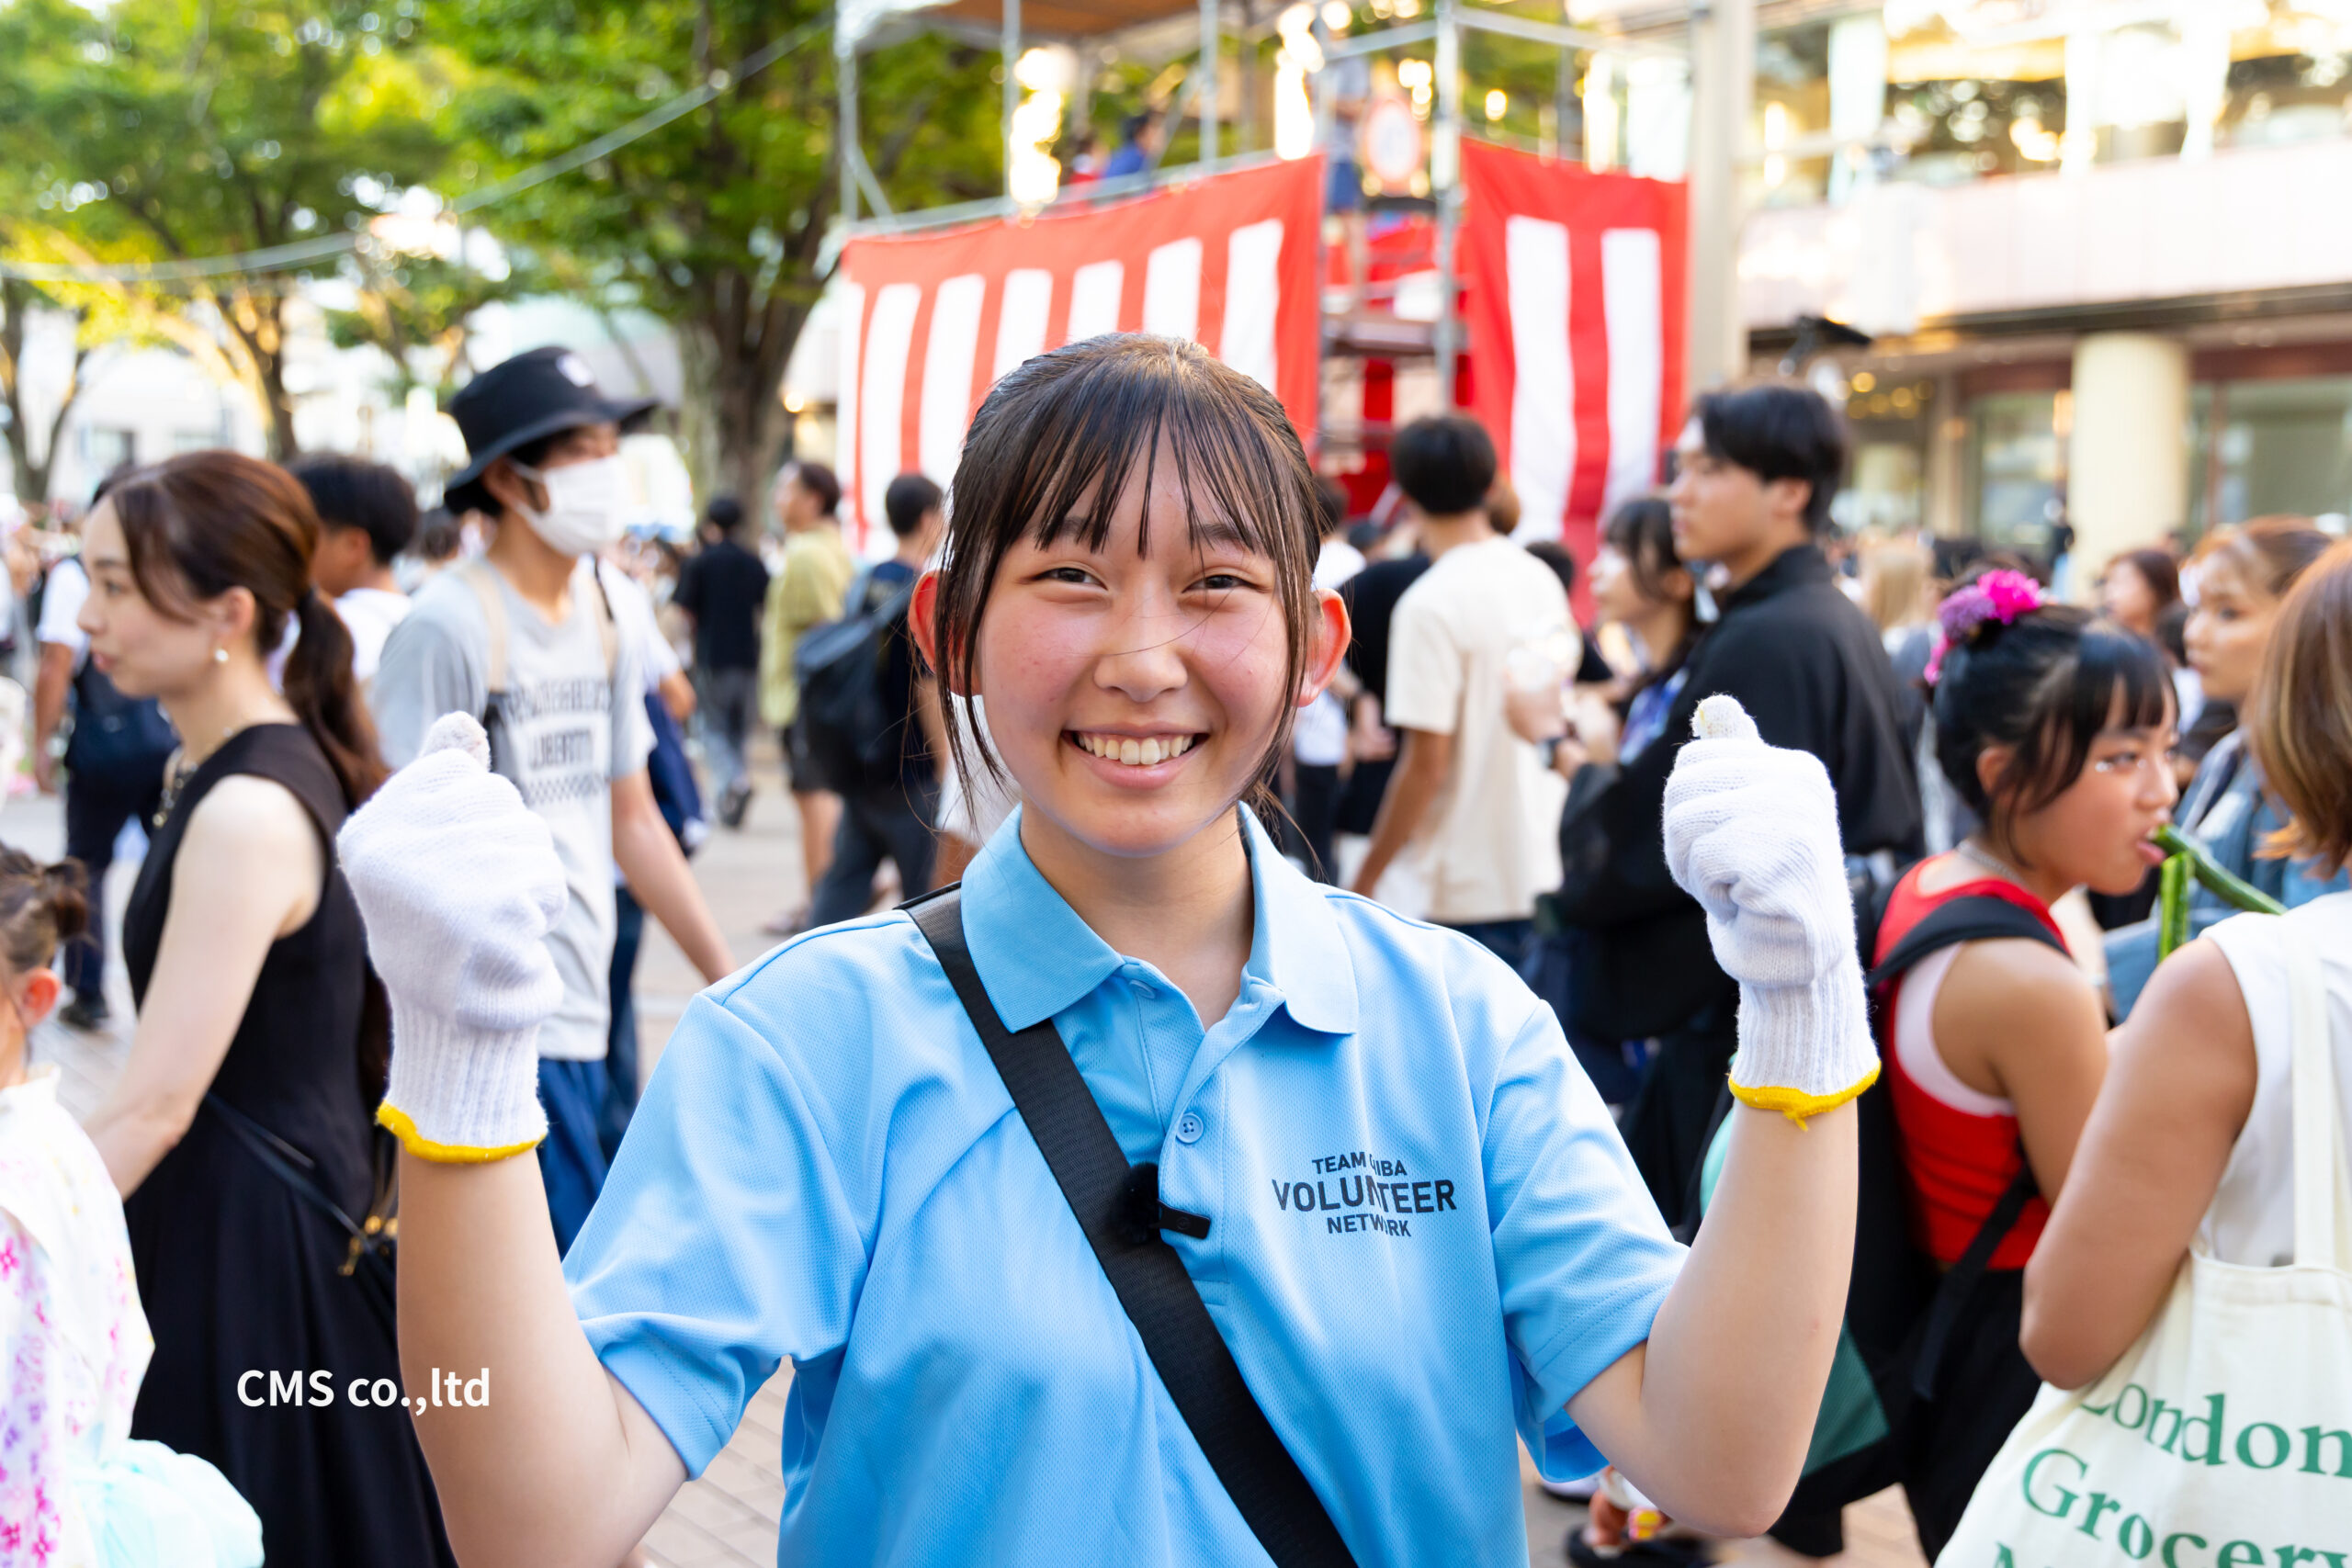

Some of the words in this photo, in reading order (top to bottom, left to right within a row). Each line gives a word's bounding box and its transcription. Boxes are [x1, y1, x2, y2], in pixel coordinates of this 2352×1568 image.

[1312, 1151, 1366, 1175] TEAM
[1272, 1174, 1457, 1213] VOLUNTEER
[2021, 1449, 2349, 1568] Grocer
